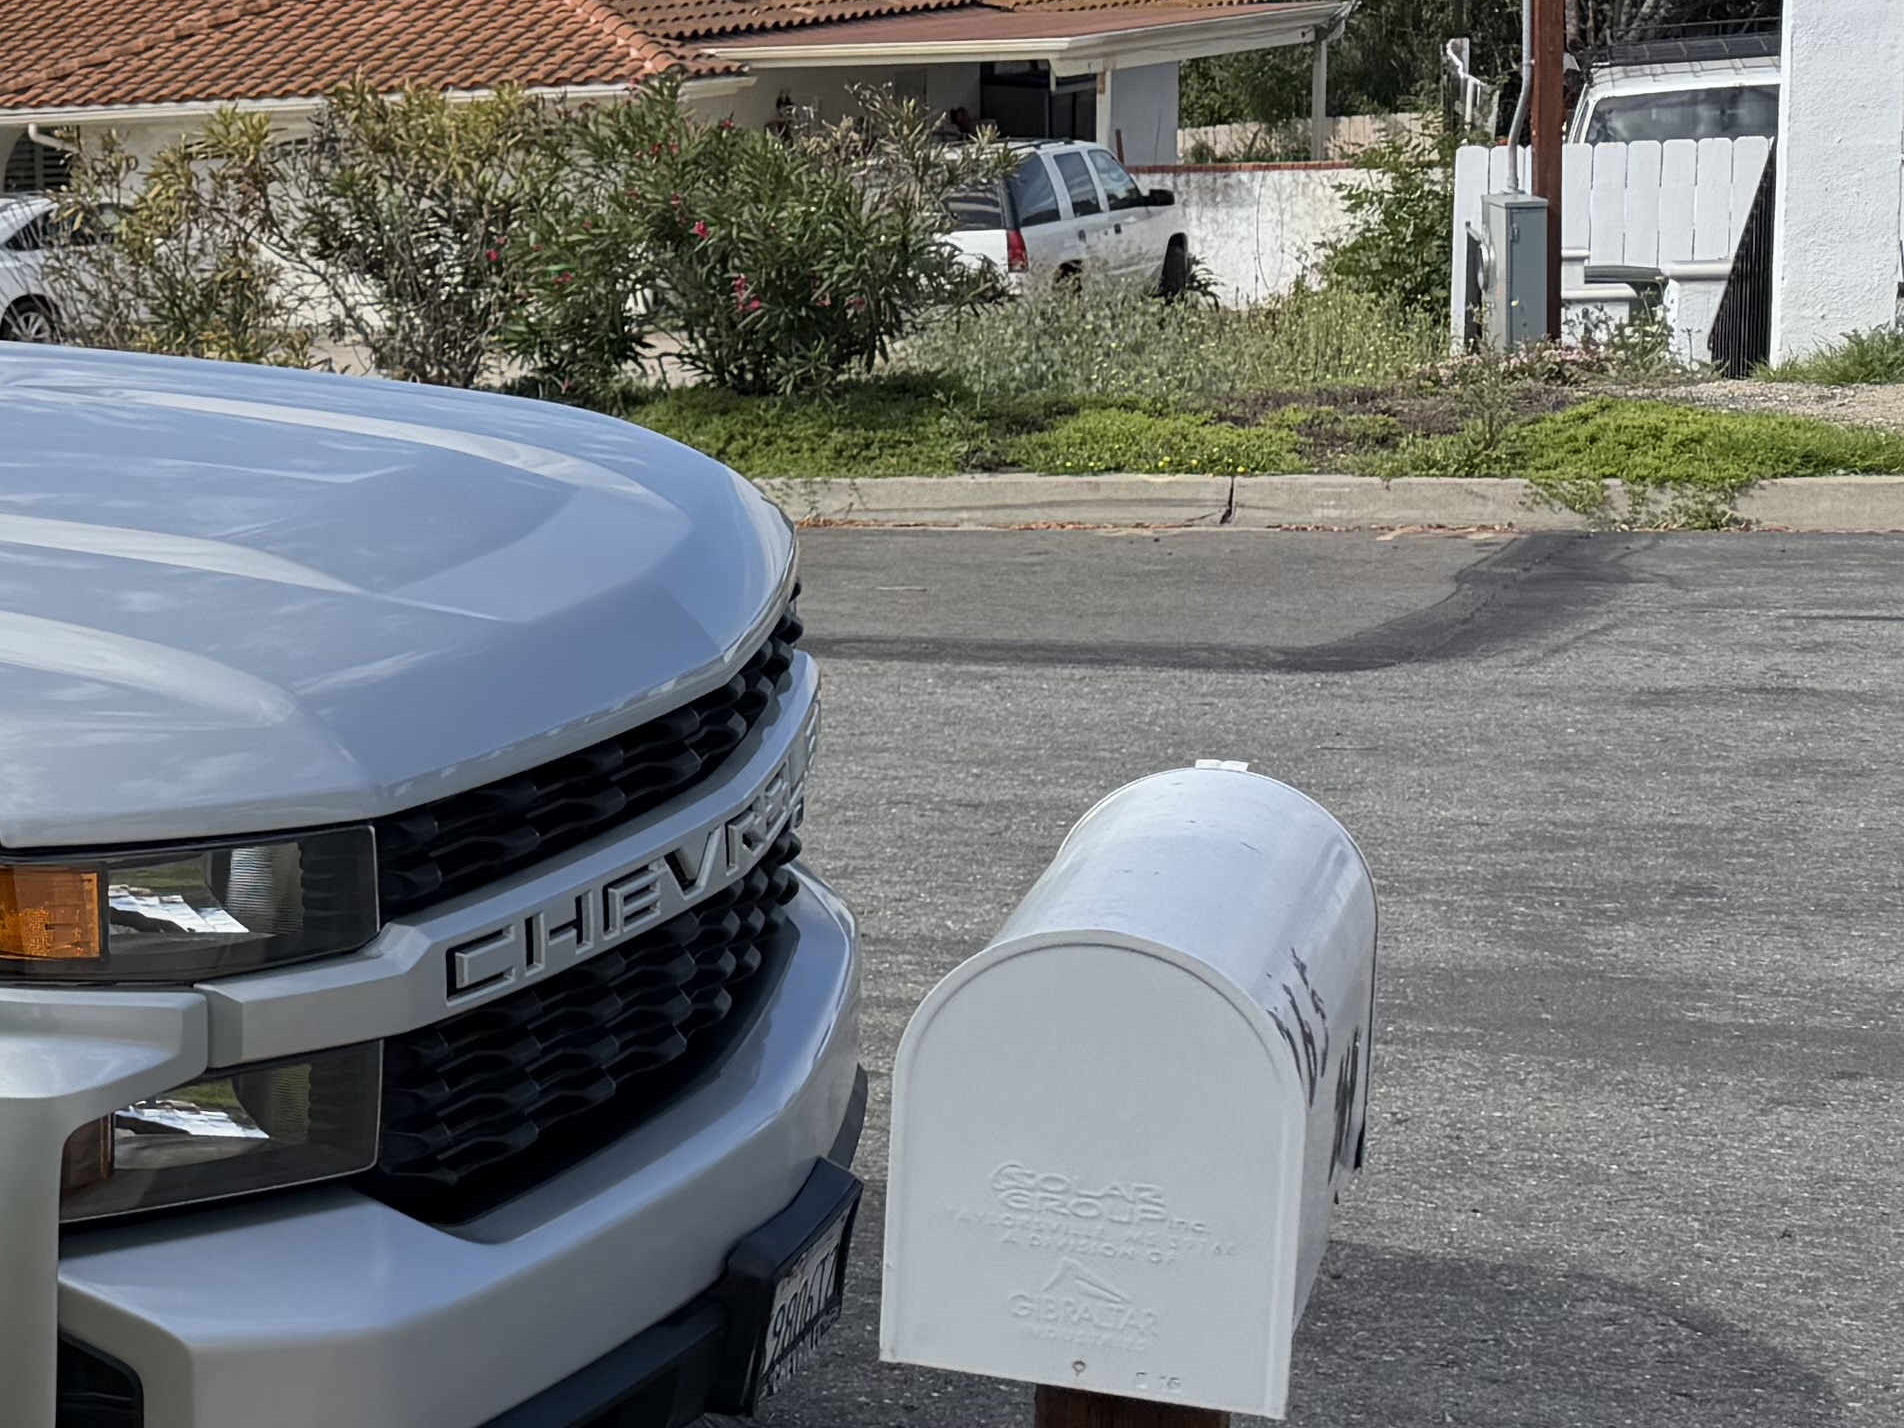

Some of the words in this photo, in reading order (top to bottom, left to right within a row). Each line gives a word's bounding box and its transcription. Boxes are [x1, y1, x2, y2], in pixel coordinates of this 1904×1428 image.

[990, 1161, 1167, 1206] SOLAR
[998, 1187, 1170, 1225] GROUP
[1008, 1291, 1161, 1337] GIBRALTAR
